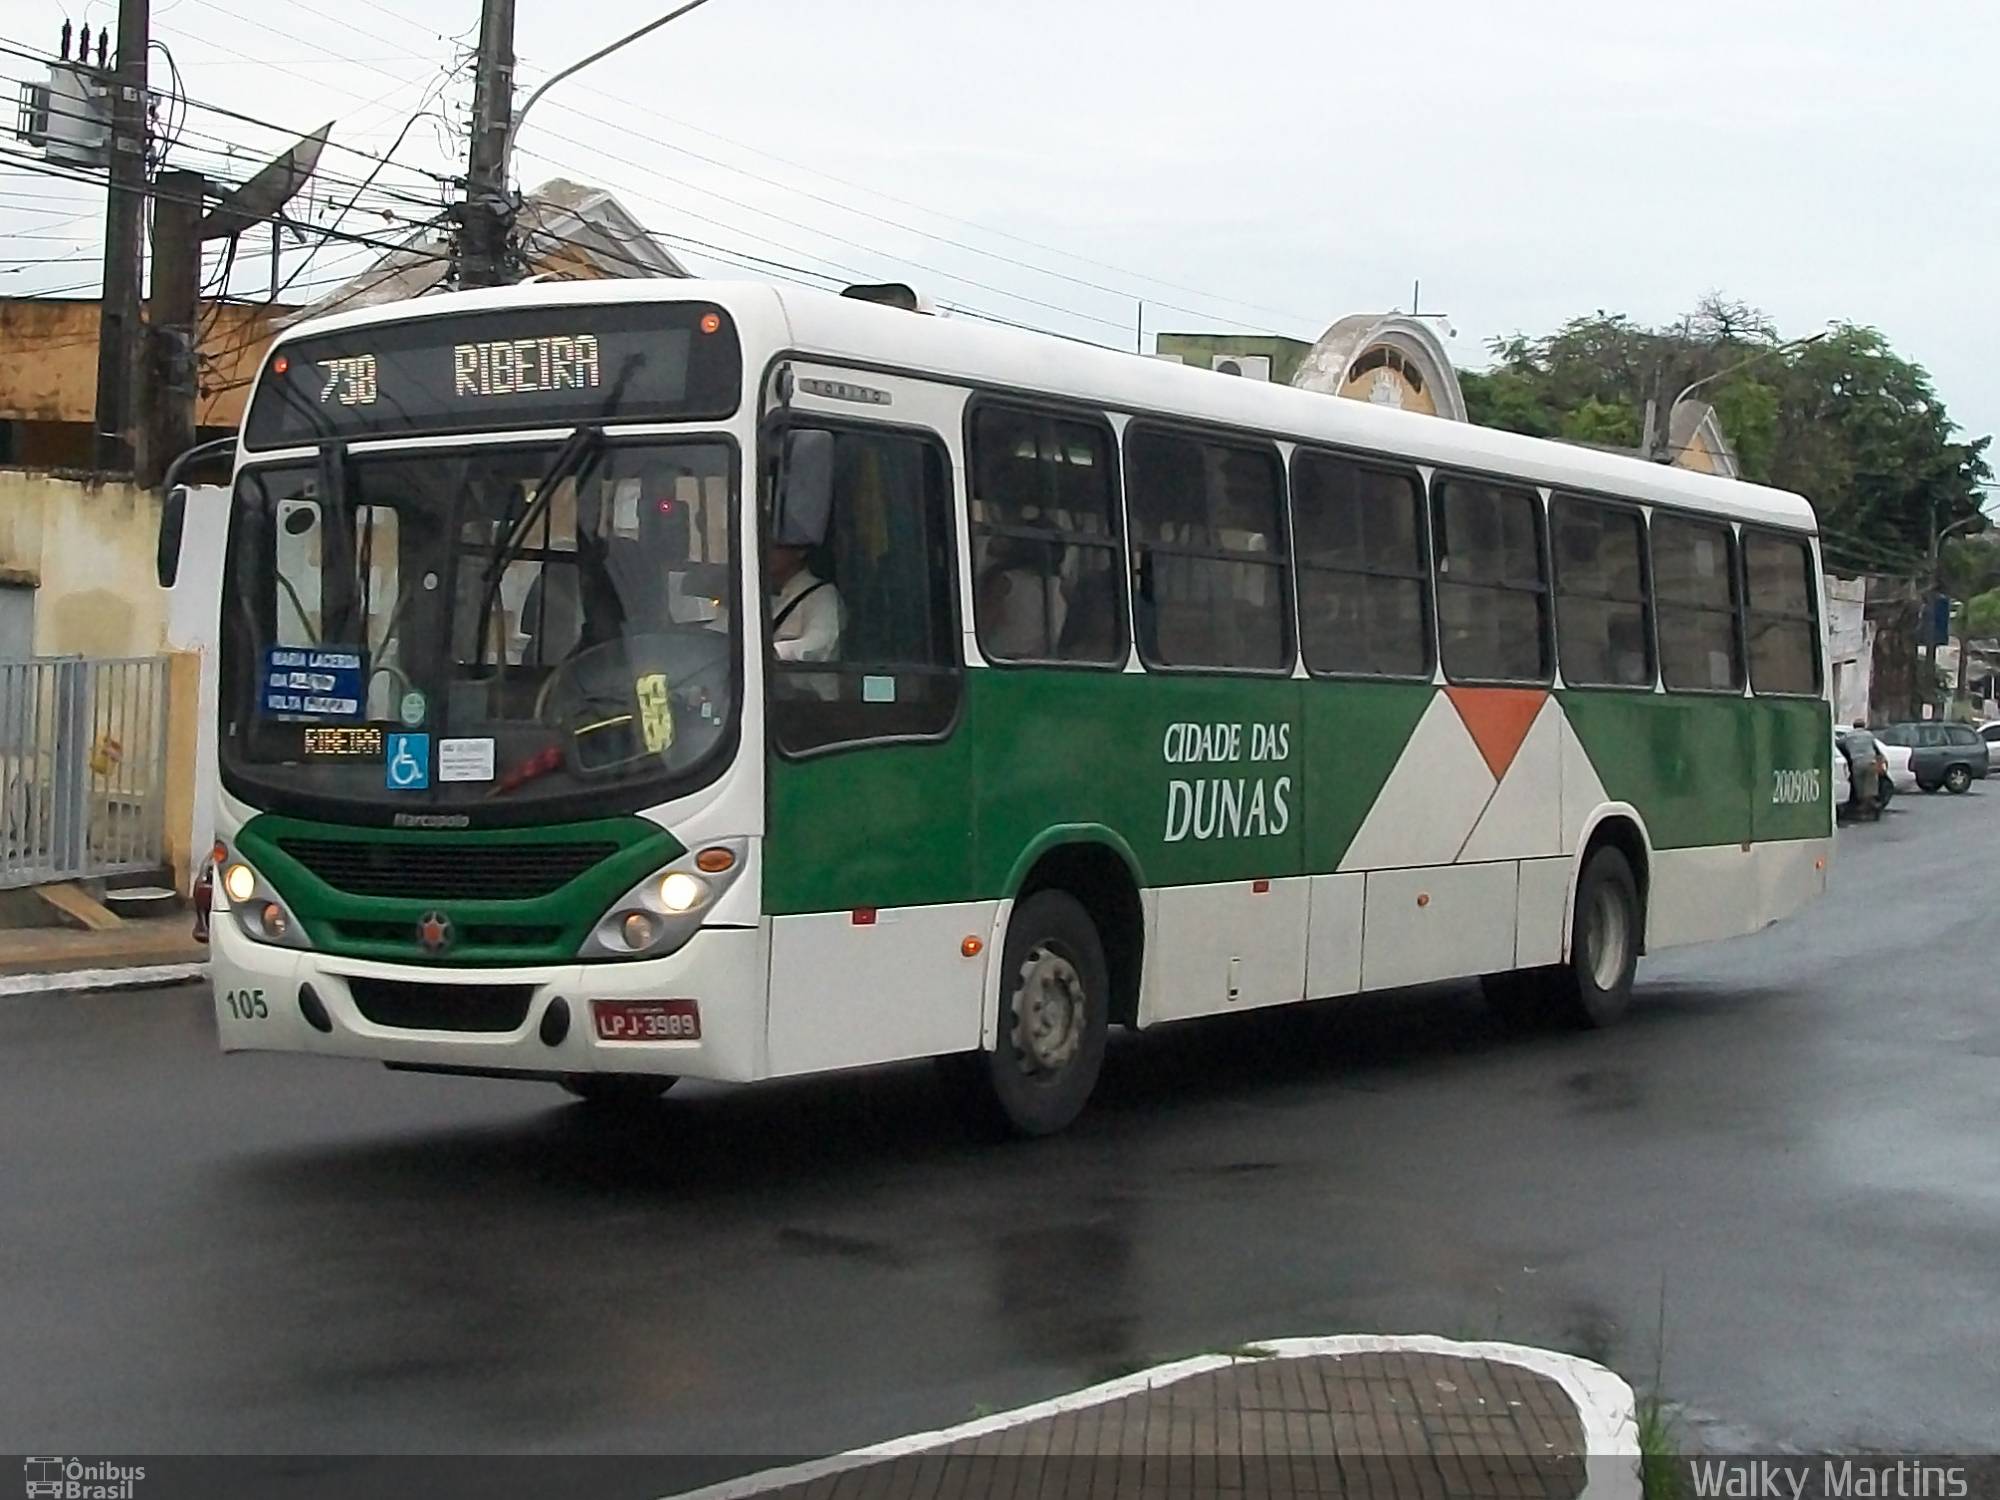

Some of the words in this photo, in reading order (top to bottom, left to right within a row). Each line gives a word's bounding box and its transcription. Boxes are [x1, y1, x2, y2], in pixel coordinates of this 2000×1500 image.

[317, 354, 376, 405] 738
[454, 334, 599, 397] RIBEIRA
[1163, 723, 1242, 762] CIDADE
[1250, 723, 1290, 761] DAS
[1772, 768, 1820, 803] 2009105
[1163, 776, 1291, 842] DUNAS
[226, 989, 268, 1019] 105
